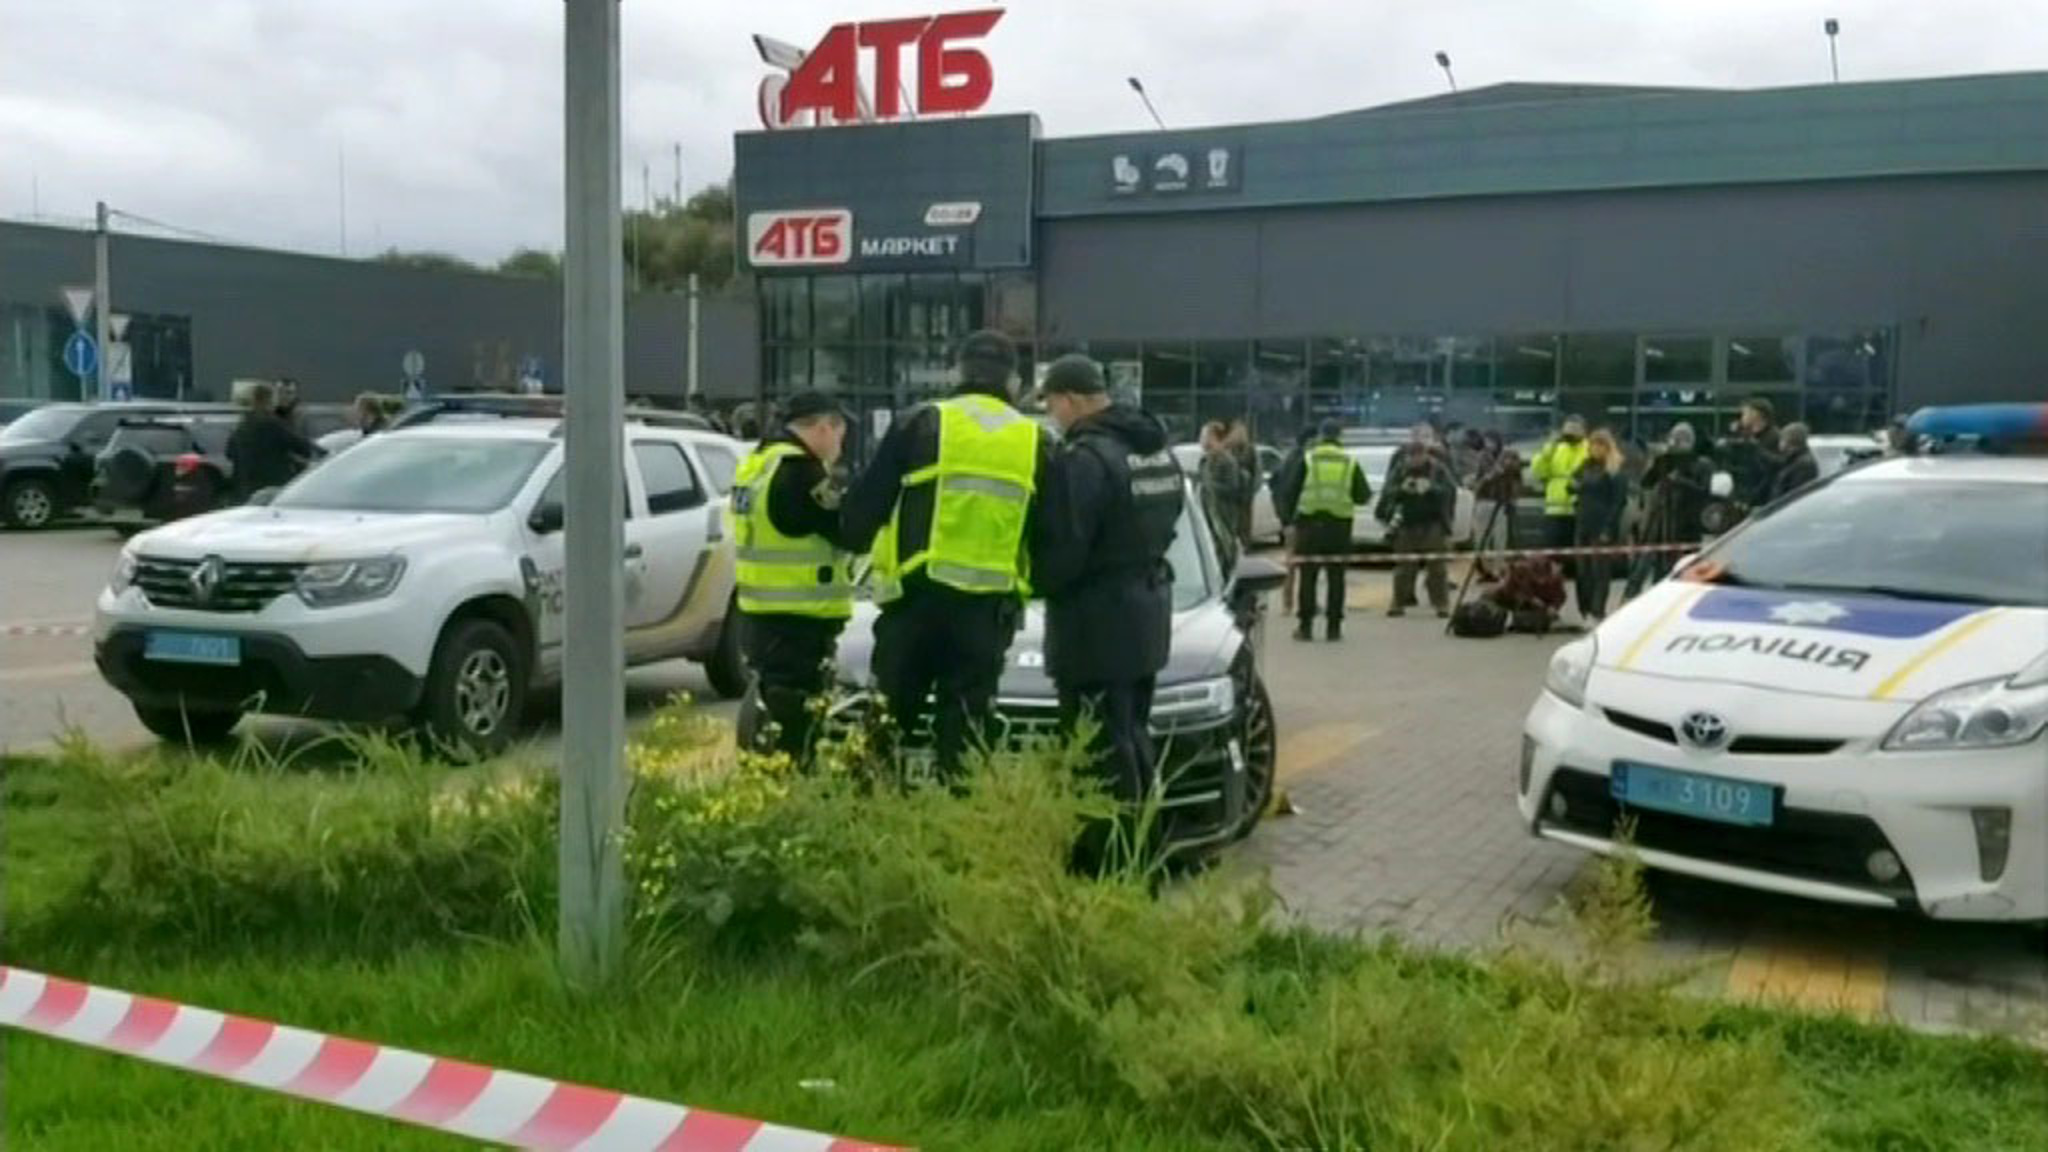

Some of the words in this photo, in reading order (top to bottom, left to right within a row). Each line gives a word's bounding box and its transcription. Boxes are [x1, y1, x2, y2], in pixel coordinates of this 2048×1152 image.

[780, 7, 1006, 124] АТБ
[755, 216, 843, 259] АТБ
[861, 234, 959, 256] МАРКЕТ
[1664, 634, 1872, 672] ПОЛІЦІЯ
[1680, 777, 1751, 815] 3109
